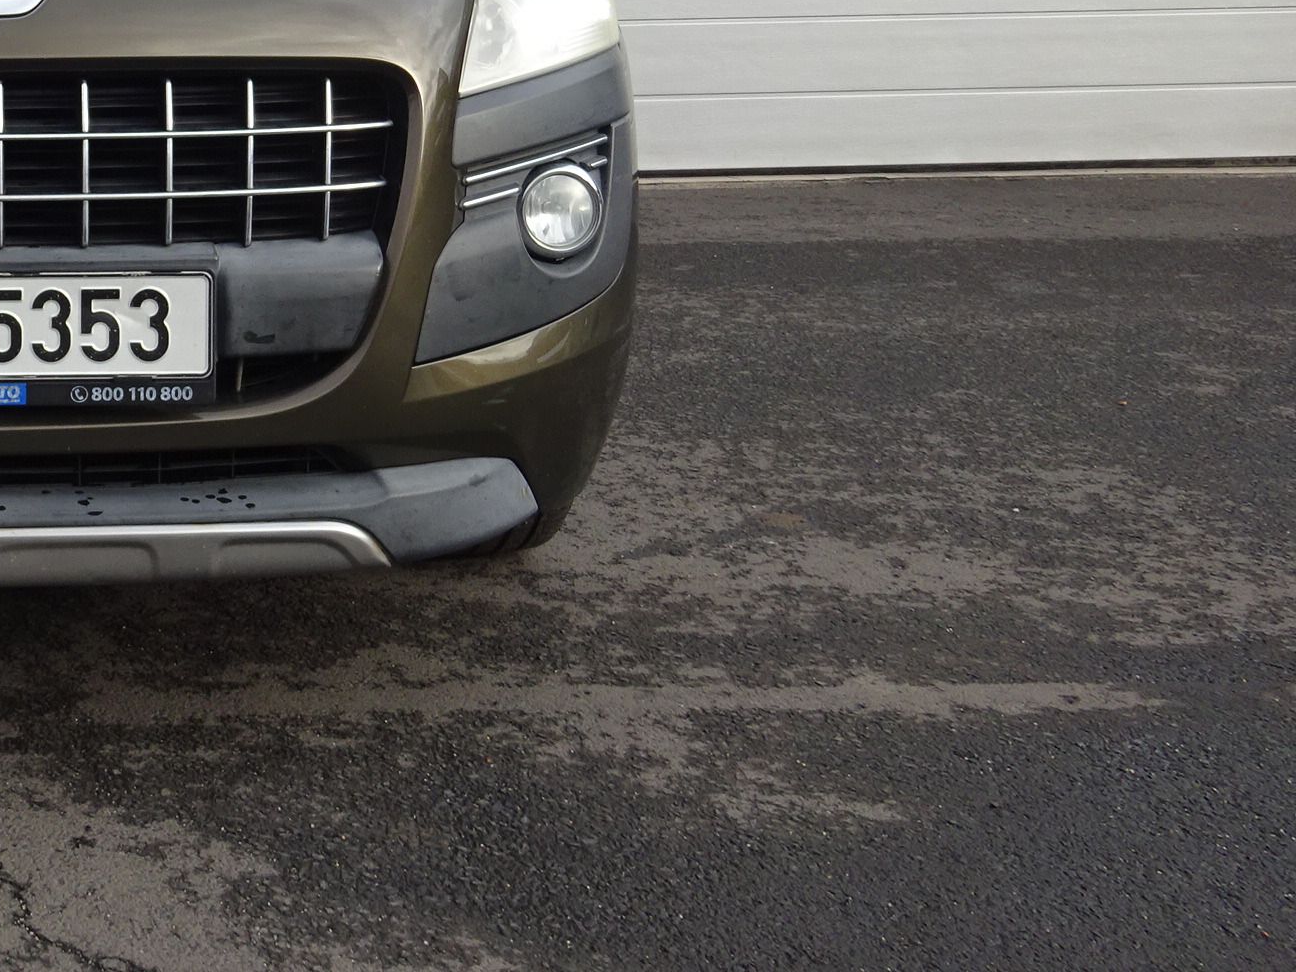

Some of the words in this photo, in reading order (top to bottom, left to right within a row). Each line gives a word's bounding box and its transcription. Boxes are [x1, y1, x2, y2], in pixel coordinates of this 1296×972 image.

[91, 386, 124, 401] 800
[128, 386, 156, 401] 110
[160, 385, 194, 401] 800
